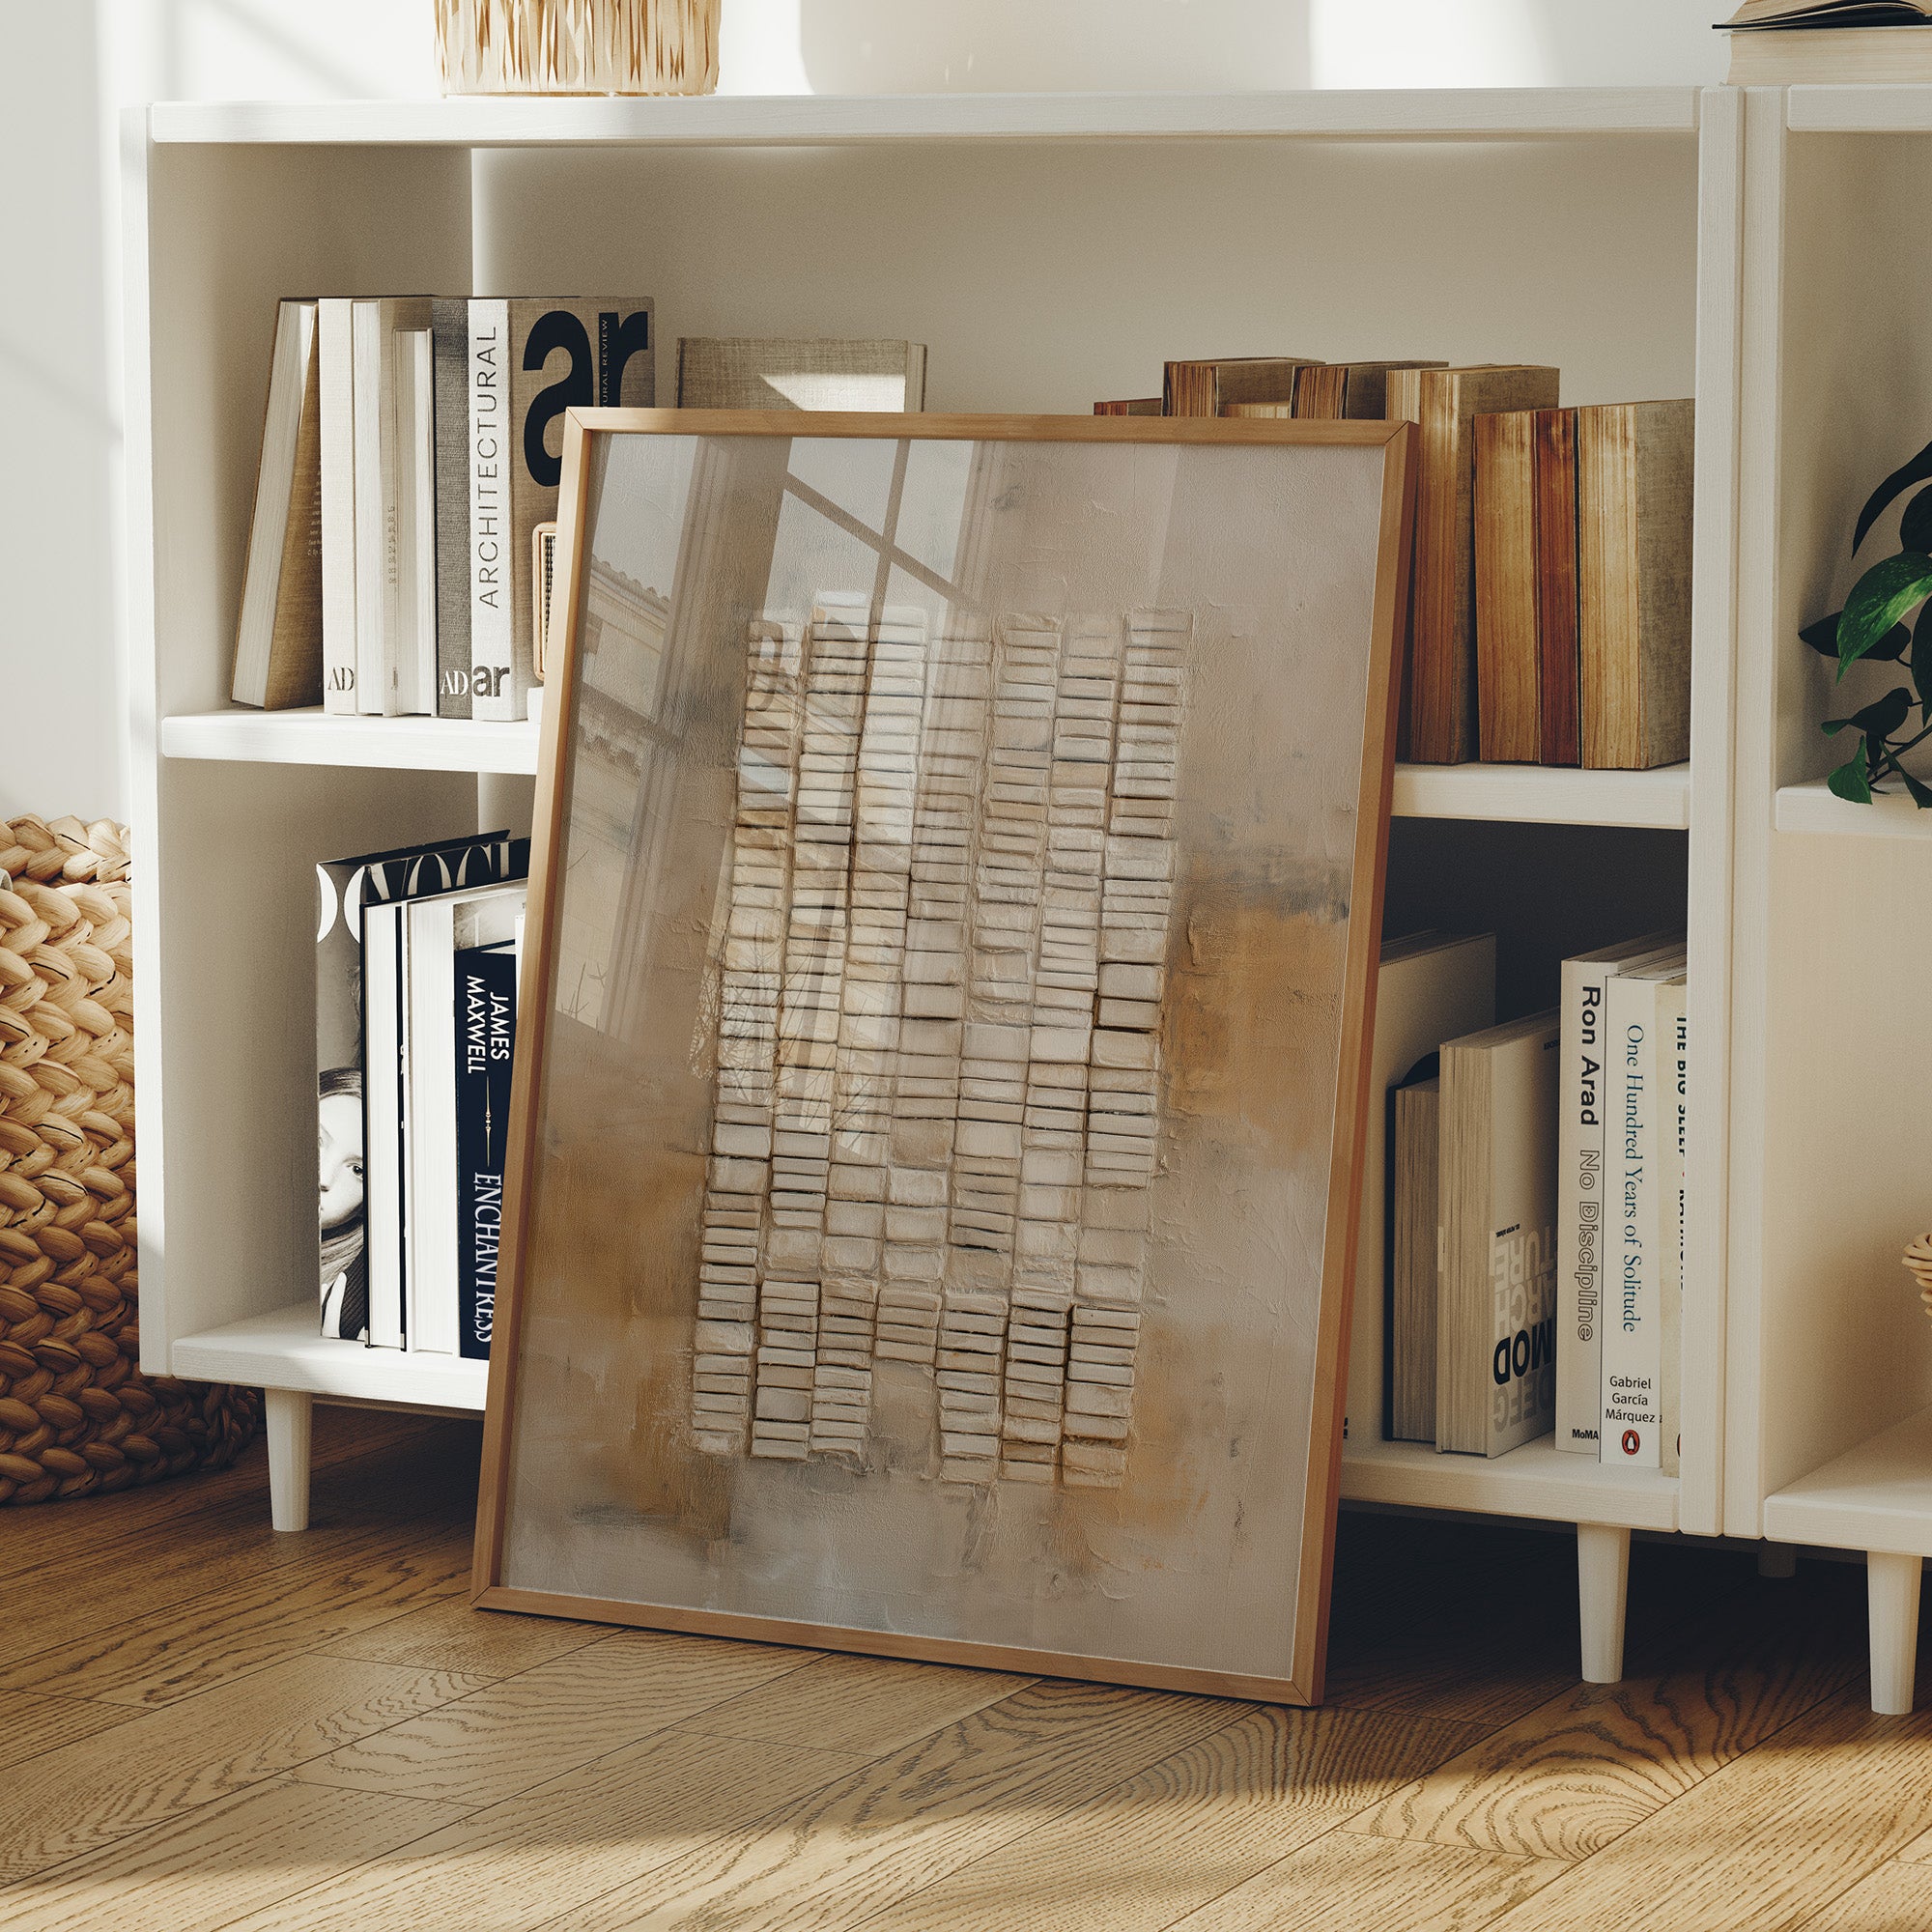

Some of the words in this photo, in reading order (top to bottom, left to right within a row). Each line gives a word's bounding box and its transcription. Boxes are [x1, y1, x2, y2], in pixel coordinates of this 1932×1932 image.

[476, 327, 499, 609] ARCHITECTURAL
[327, 667, 355, 691] AD
[440, 670, 469, 695] AD
[472, 665, 510, 697] ar
[467, 975, 486, 1074] MAXWELL
[490, 991, 510, 1061] JAMES
[1582, 985, 1601, 1045] Ron
[1626, 1024, 1644, 1066] One
[1580, 1055, 1601, 1125] Arad
[1625, 1074, 1643, 1159] Hundred
[1579, 1150, 1600, 1190] No
[1625, 1166, 1643, 1218] Years
[1624, 1225, 1642, 1248] of
[1575, 1201, 1600, 1342] Discipline
[1623, 1254, 1642, 1332] Solitude
[1493, 1319, 1552, 1385] MOD
[1609, 1376, 1651, 1389] Gabriel
[1611, 1392, 1648, 1406] García
[1572, 1428, 1599, 1440] MoMA
[1605, 1408, 1655, 1424] Márquez
